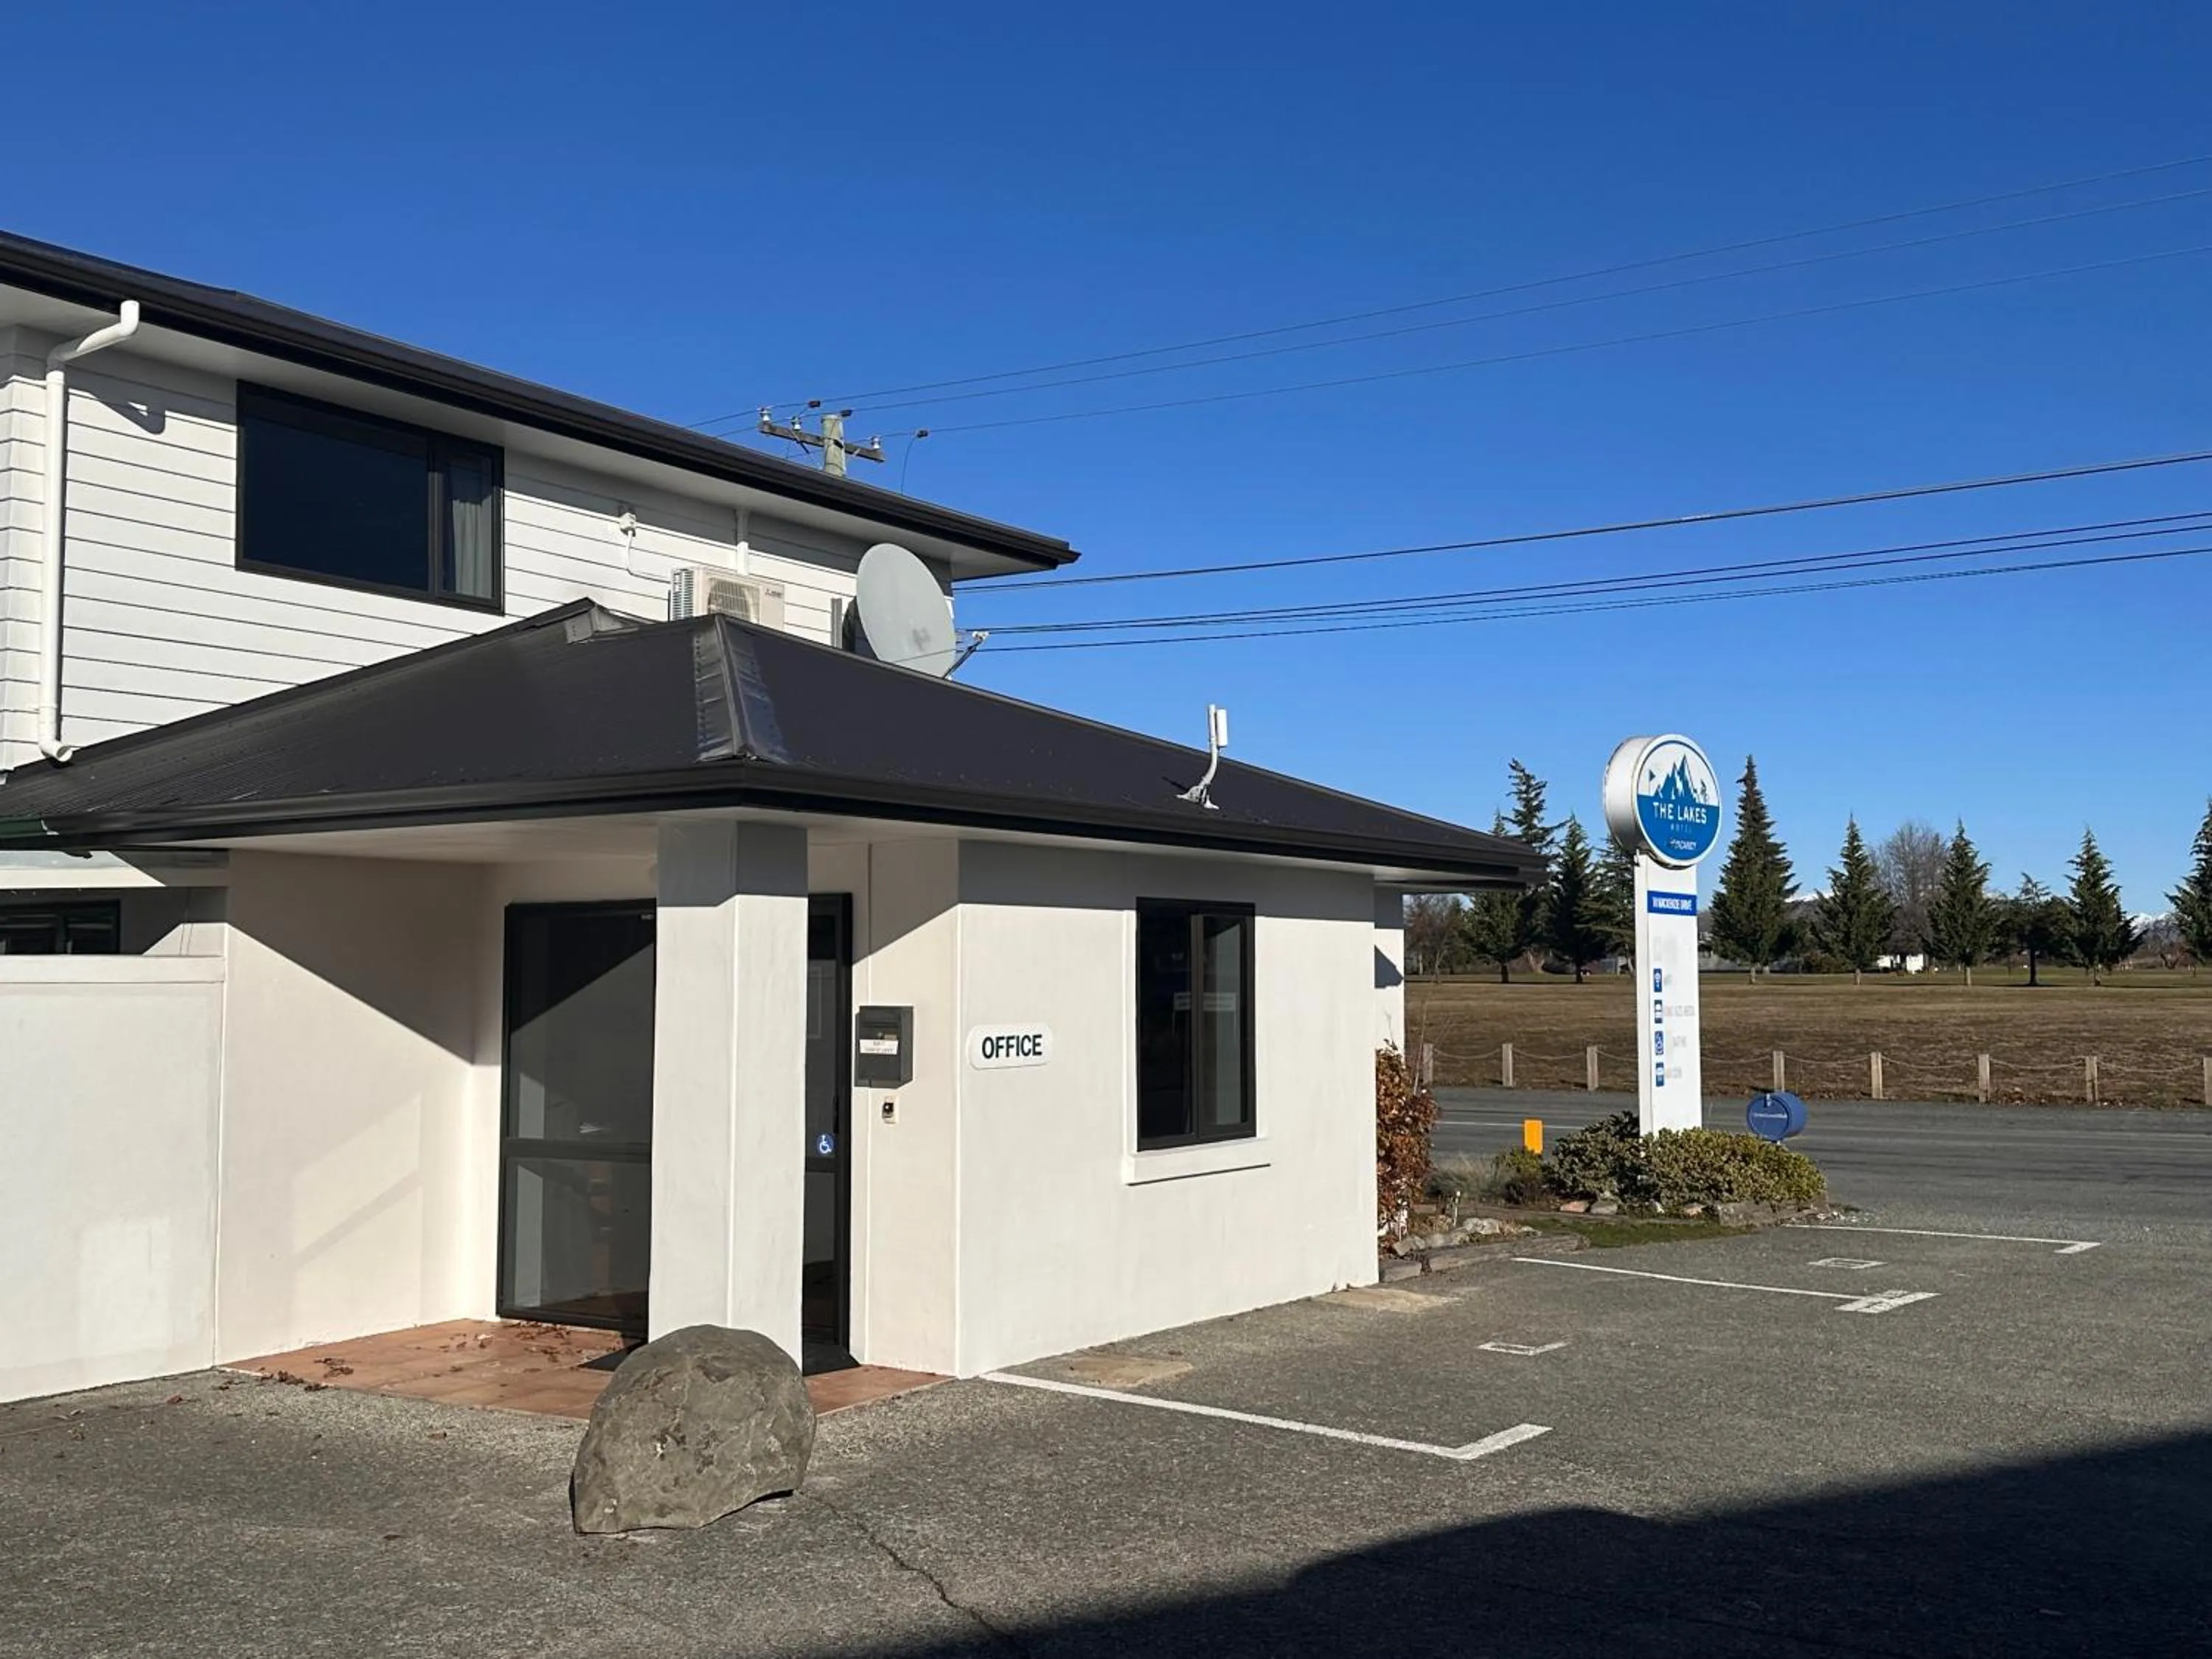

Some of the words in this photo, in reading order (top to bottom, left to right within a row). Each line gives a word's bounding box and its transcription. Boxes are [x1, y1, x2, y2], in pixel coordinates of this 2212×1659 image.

[1652, 801, 1674, 820] THE
[1677, 804, 1707, 825] LAKES
[982, 1034, 1043, 1059] OFFICE
